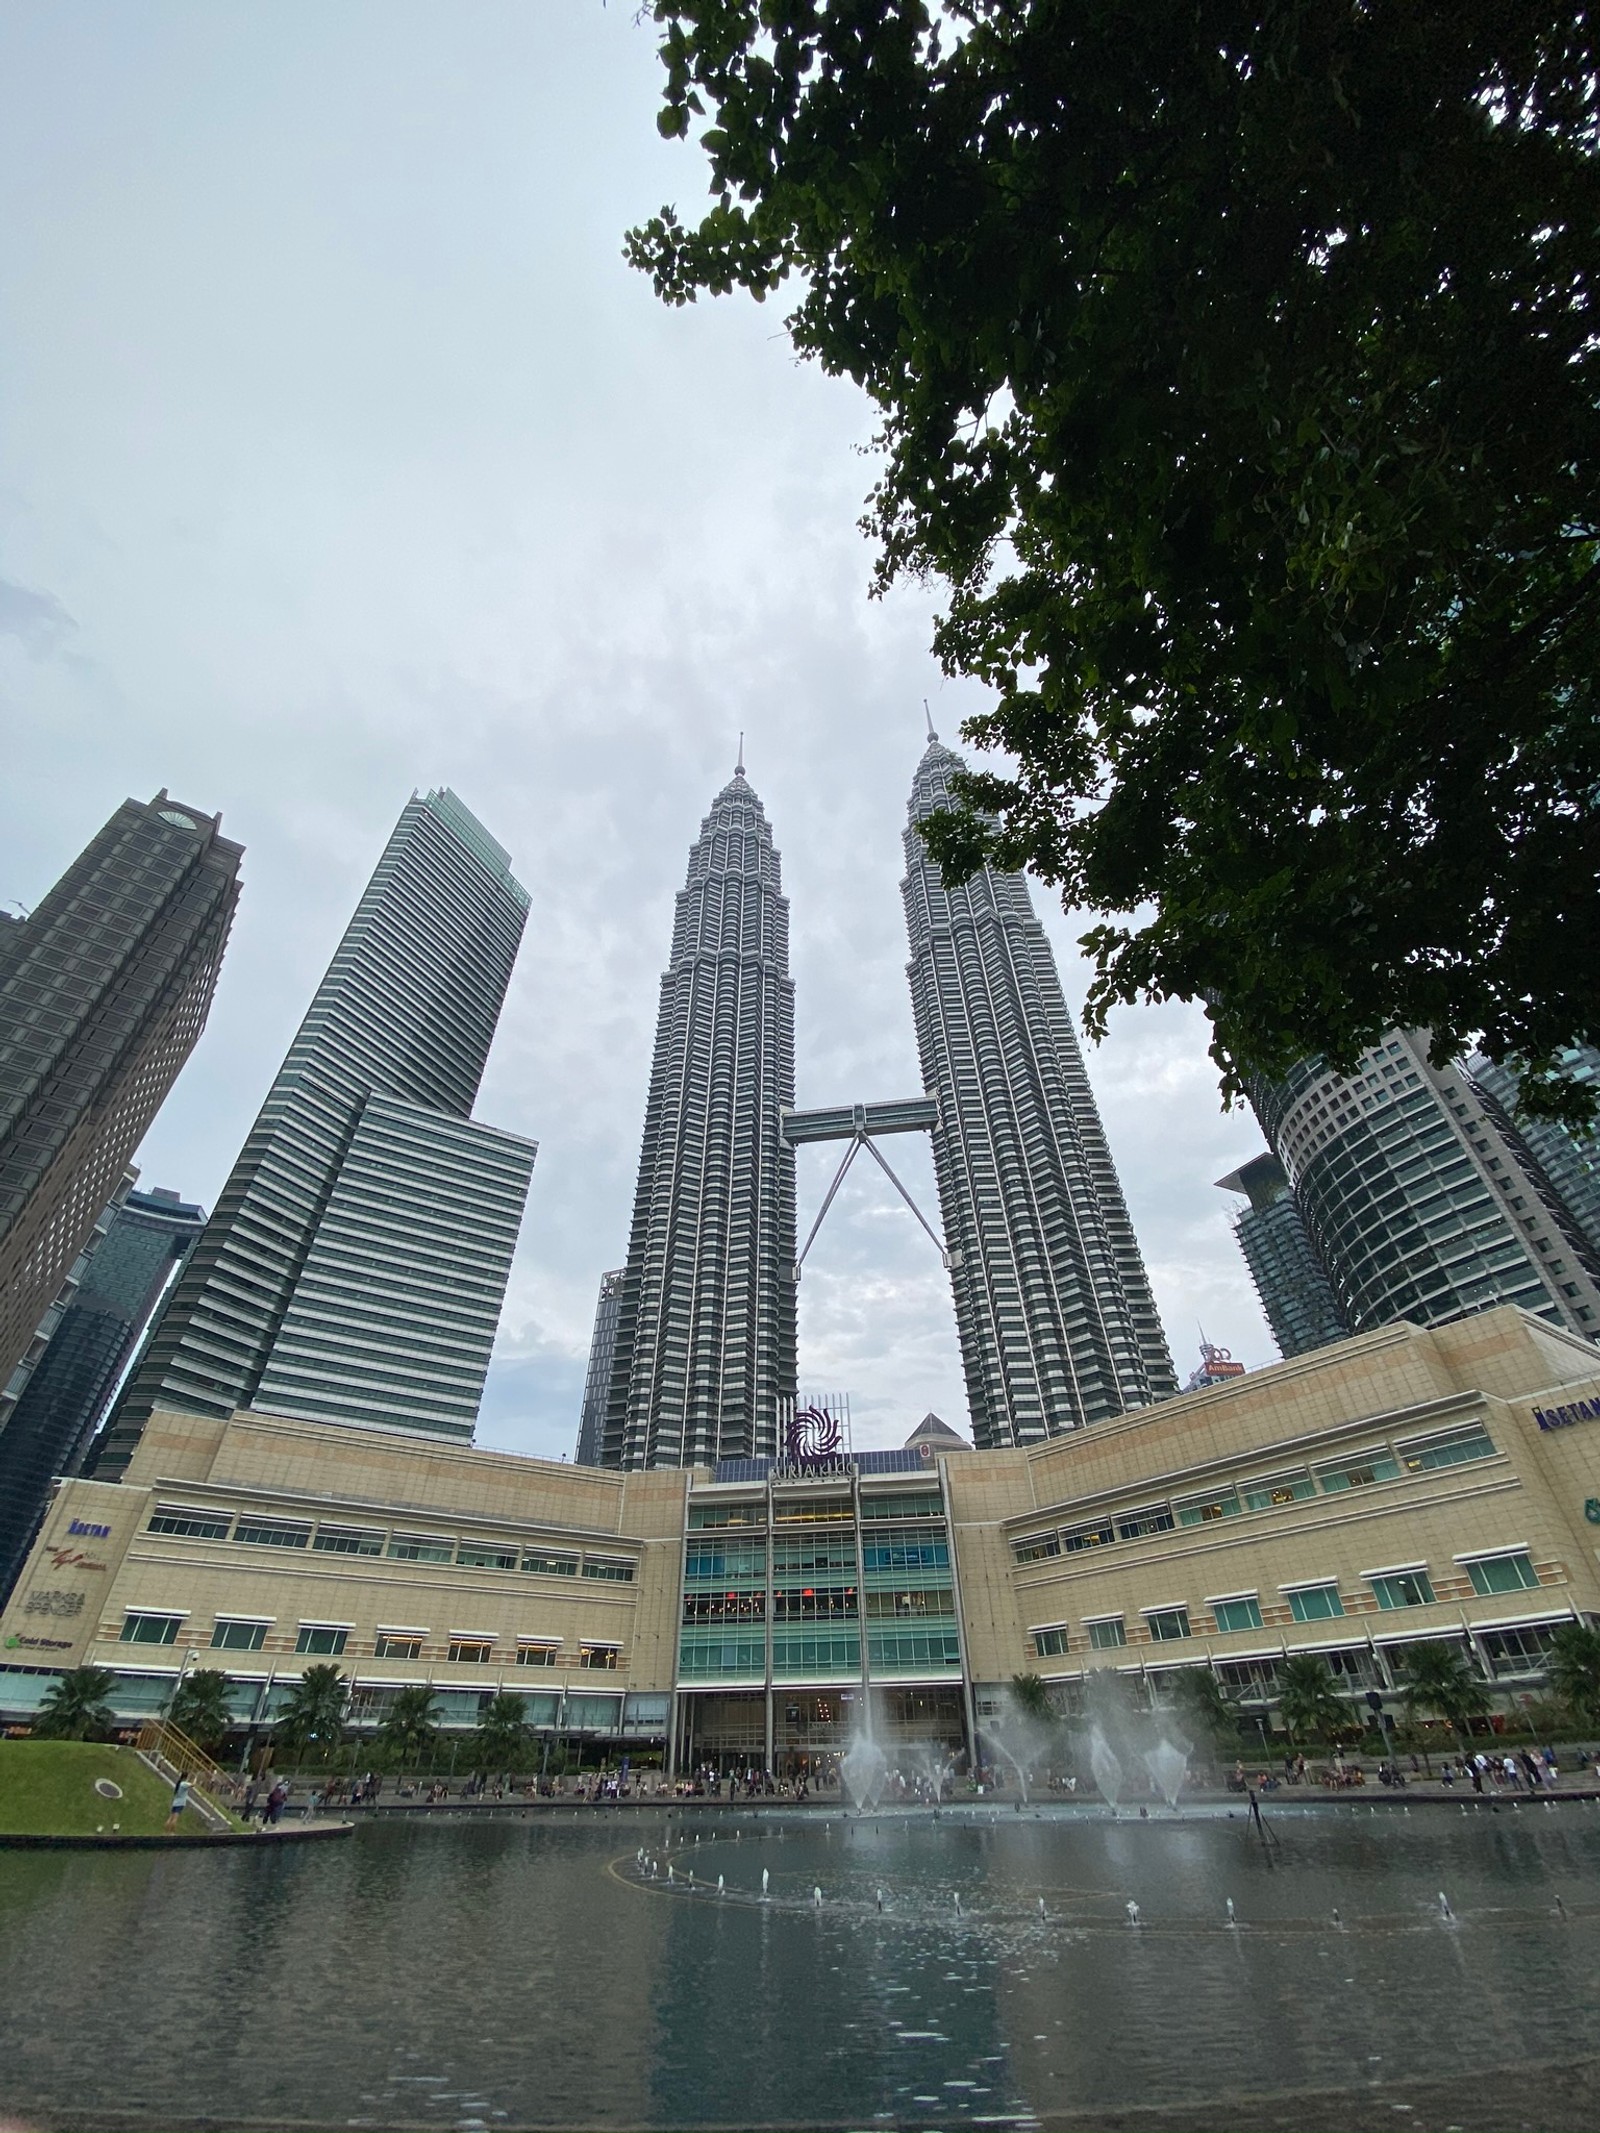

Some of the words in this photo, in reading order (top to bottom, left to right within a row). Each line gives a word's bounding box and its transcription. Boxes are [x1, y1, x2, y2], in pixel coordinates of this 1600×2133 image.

[1208, 1364, 1243, 1372] AmBank
[19, 1636, 40, 1645] Cold
[40, 1638, 73, 1649] Storage
